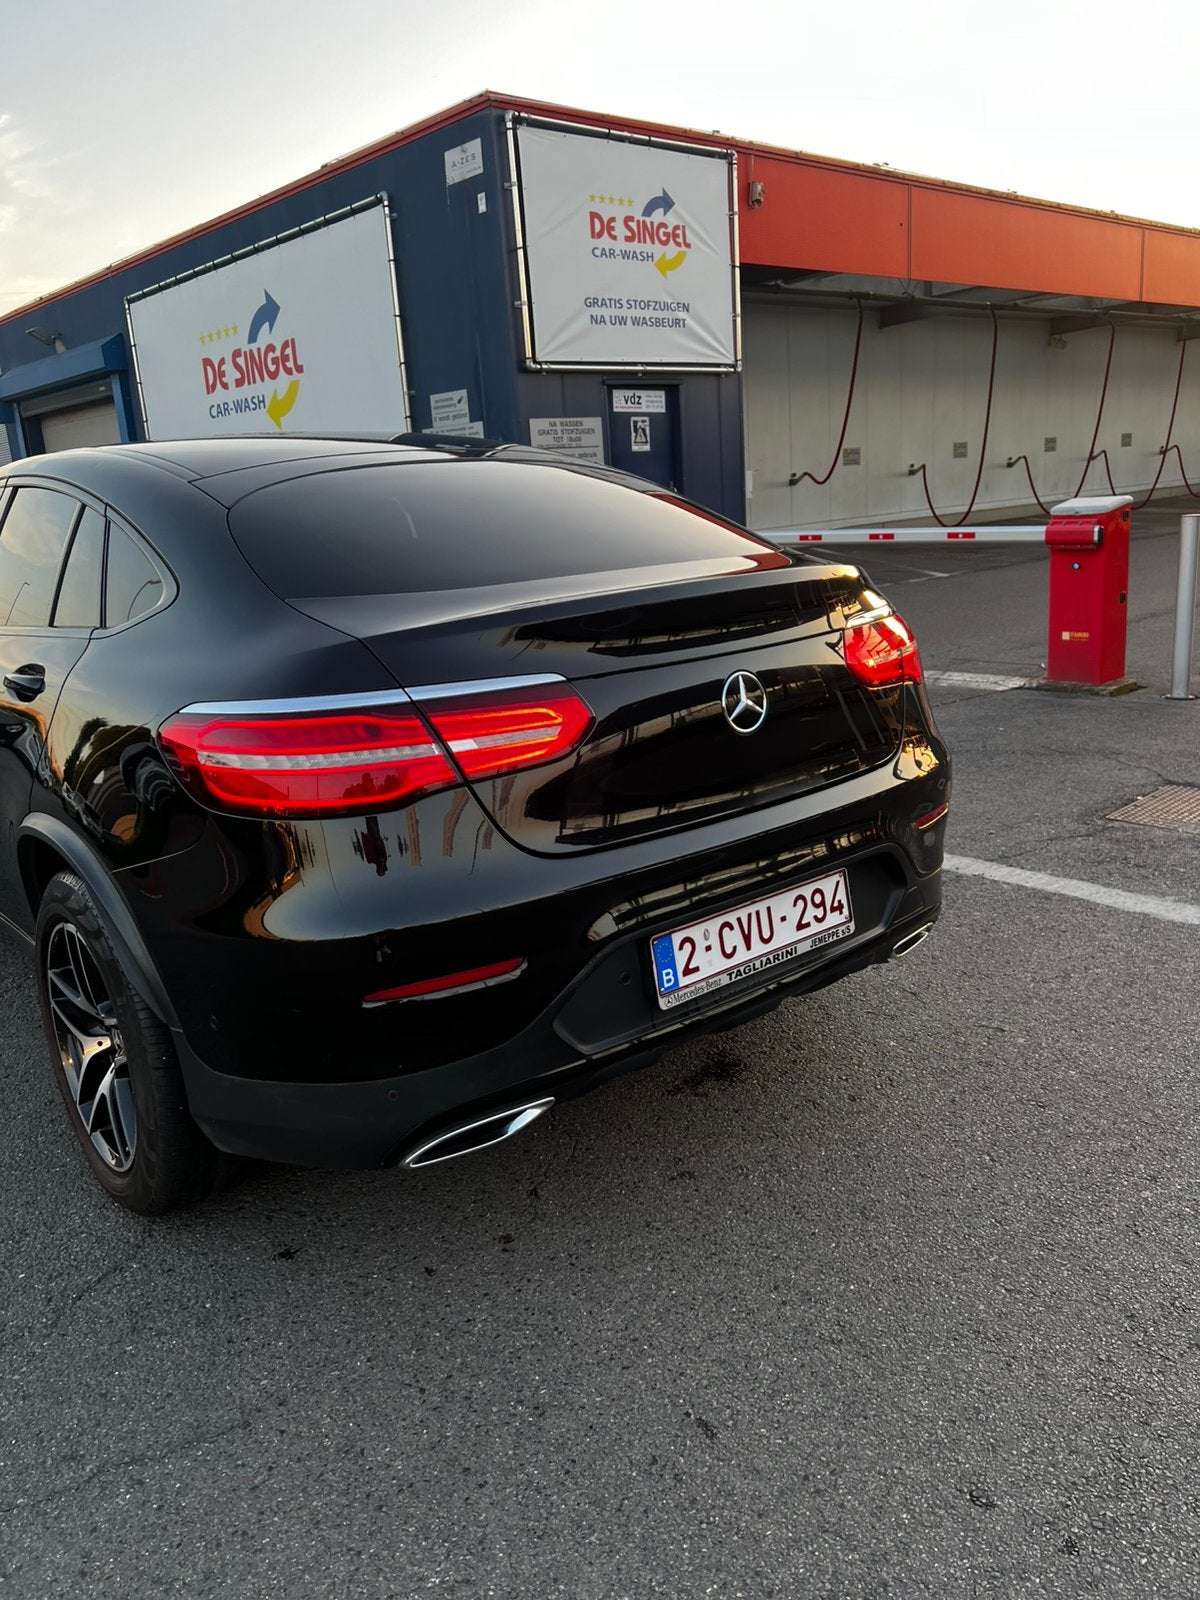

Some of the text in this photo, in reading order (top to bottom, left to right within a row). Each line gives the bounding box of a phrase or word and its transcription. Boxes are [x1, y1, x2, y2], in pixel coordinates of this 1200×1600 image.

[588, 211, 692, 250] DE SINGEL
[591, 247, 655, 263] CAR-WASH
[584, 297, 690, 313] GRATIS STOFZUIGEN
[590, 314, 687, 329] NA UW WASBEURT
[201, 338, 305, 396] DE SINGEL
[209, 394, 267, 419] CAR-WASH
[623, 392, 642, 405] vdz
[537, 427, 596, 436] GRATIS STOFZUIGEN
[560, 420, 584, 428] WASSEN
[678, 880, 844, 977] 2-CVU-294
[673, 978, 722, 1003] Mercedes-Benz
[727, 946, 798, 982] TAGLIARINI
[810, 930, 841, 949] JEMEPPE
[662, 968, 675, 988] B
